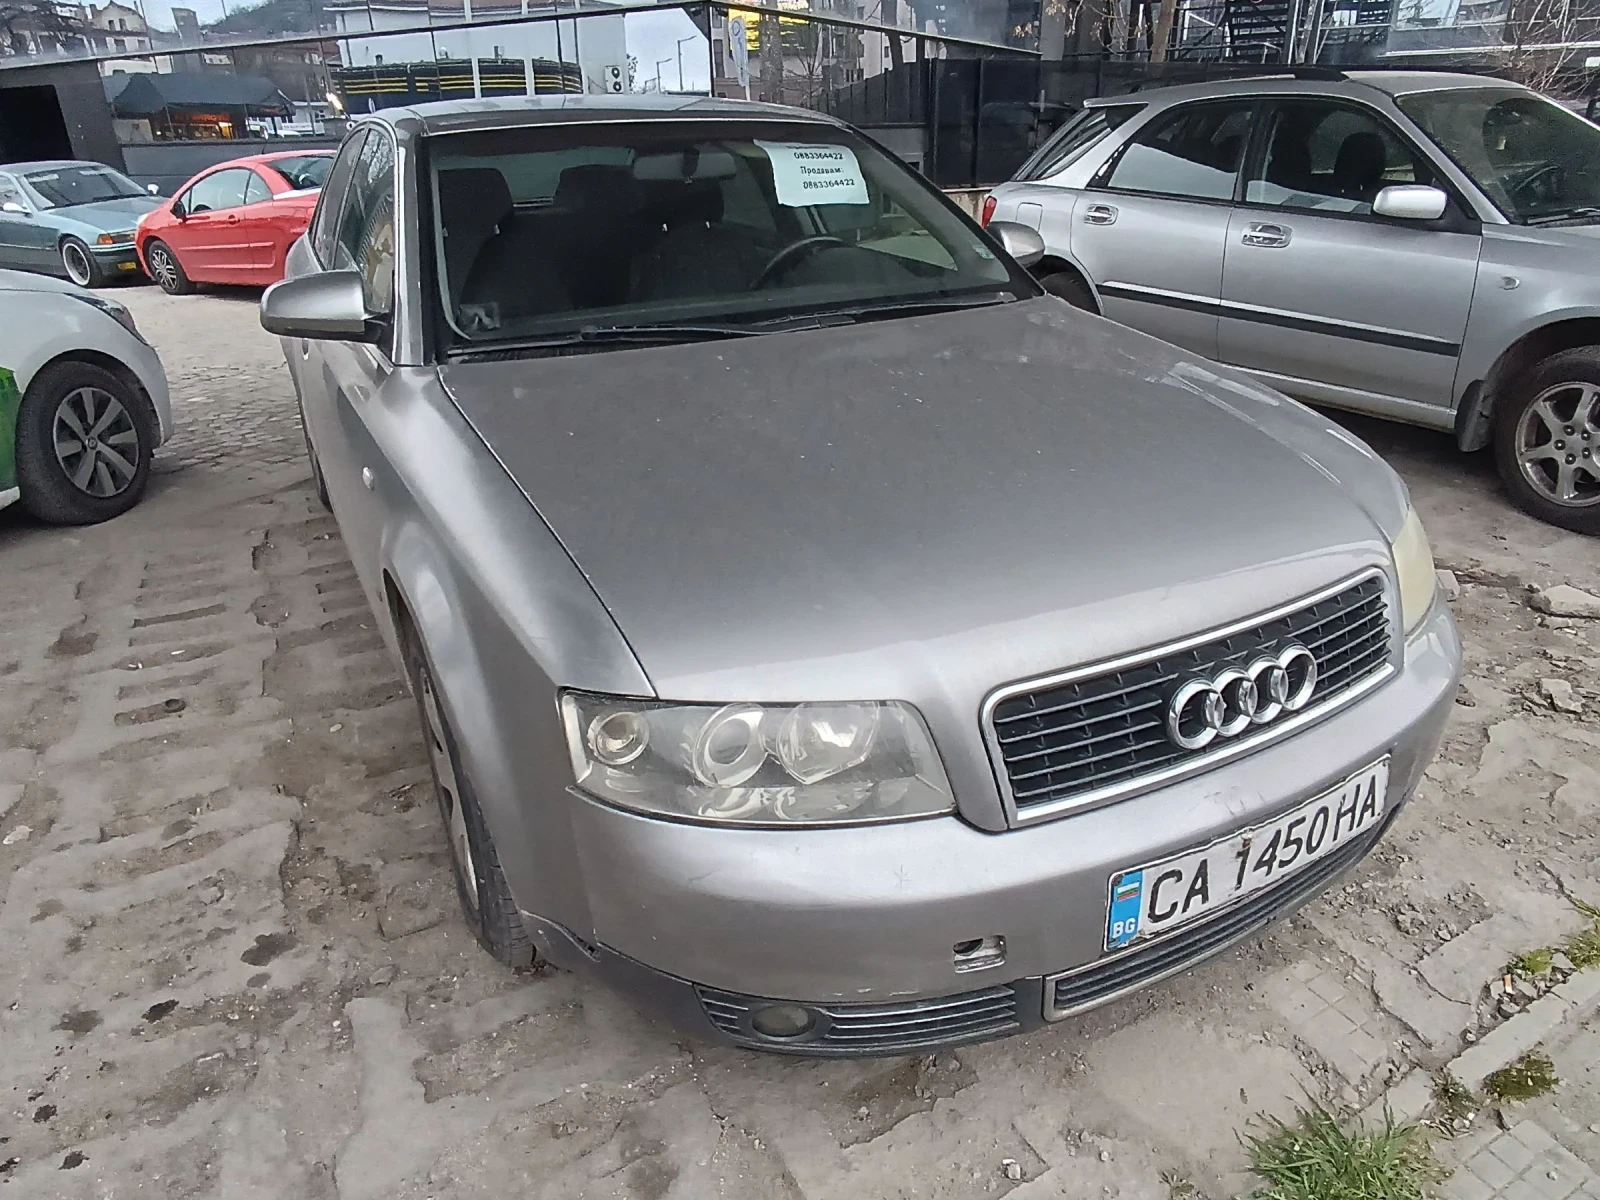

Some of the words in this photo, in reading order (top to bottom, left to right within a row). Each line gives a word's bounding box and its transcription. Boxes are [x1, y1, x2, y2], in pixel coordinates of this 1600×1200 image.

[793, 152, 844, 160] 0883364422
[803, 178, 855, 189] 0883364422
[1147, 858, 1210, 924] CA
[1111, 917, 1137, 939] BG
